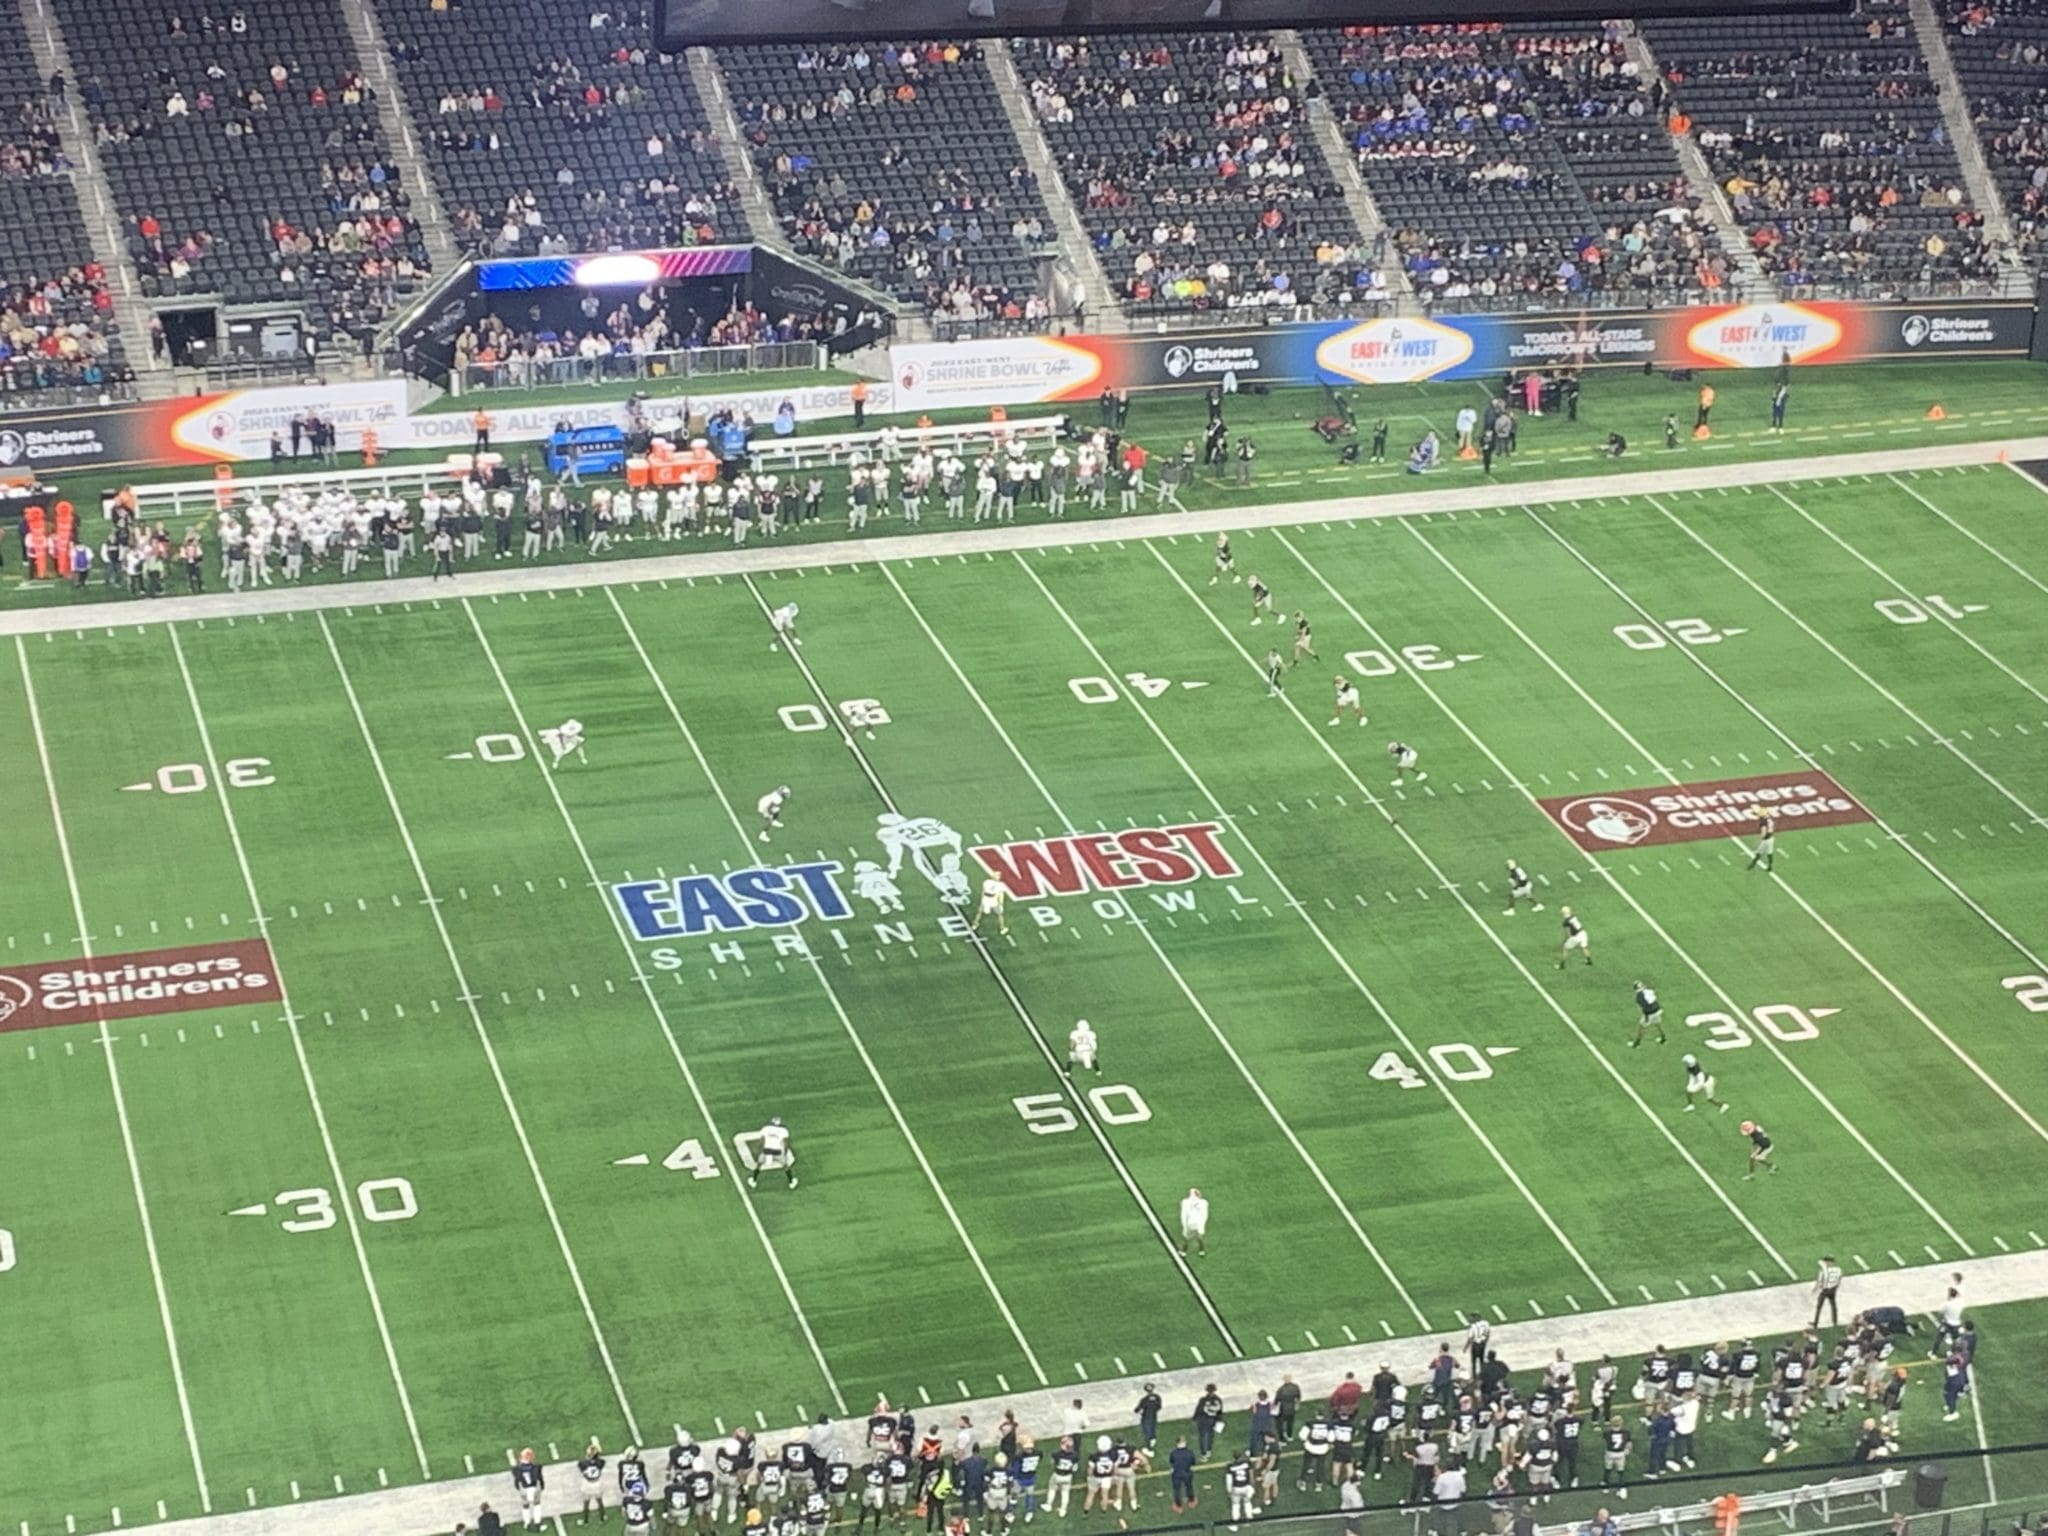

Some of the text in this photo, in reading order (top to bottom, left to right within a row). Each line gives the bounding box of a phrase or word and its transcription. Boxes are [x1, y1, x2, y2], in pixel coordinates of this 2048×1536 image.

[1351, 340, 1438, 359] EAST WEST
[1720, 325, 1807, 343] EAST WEST
[926, 364, 987, 382] SHRINE
[991, 362, 1041, 378] BOWL
[801, 388, 890, 410] LEGEDS
[26, 429, 96, 445] Shriners
[1873, 595, 1964, 624] 10
[1613, 618, 1722, 650] 20
[1344, 644, 1457, 678] 30
[1068, 672, 1171, 703] 40
[157, 757, 276, 794] 30
[1649, 783, 1818, 813] Shriners
[611, 822, 1243, 940] EAST WEST
[652, 883, 1259, 970] SHRINE BOWL
[38, 957, 242, 991] Shriners
[41, 972, 269, 1010] Children's
[1686, 1004, 1819, 1051] 30
[1368, 1043, 1493, 1089] 40
[1012, 1084, 1152, 1135] 50
[274, 1177, 419, 1233] 30
